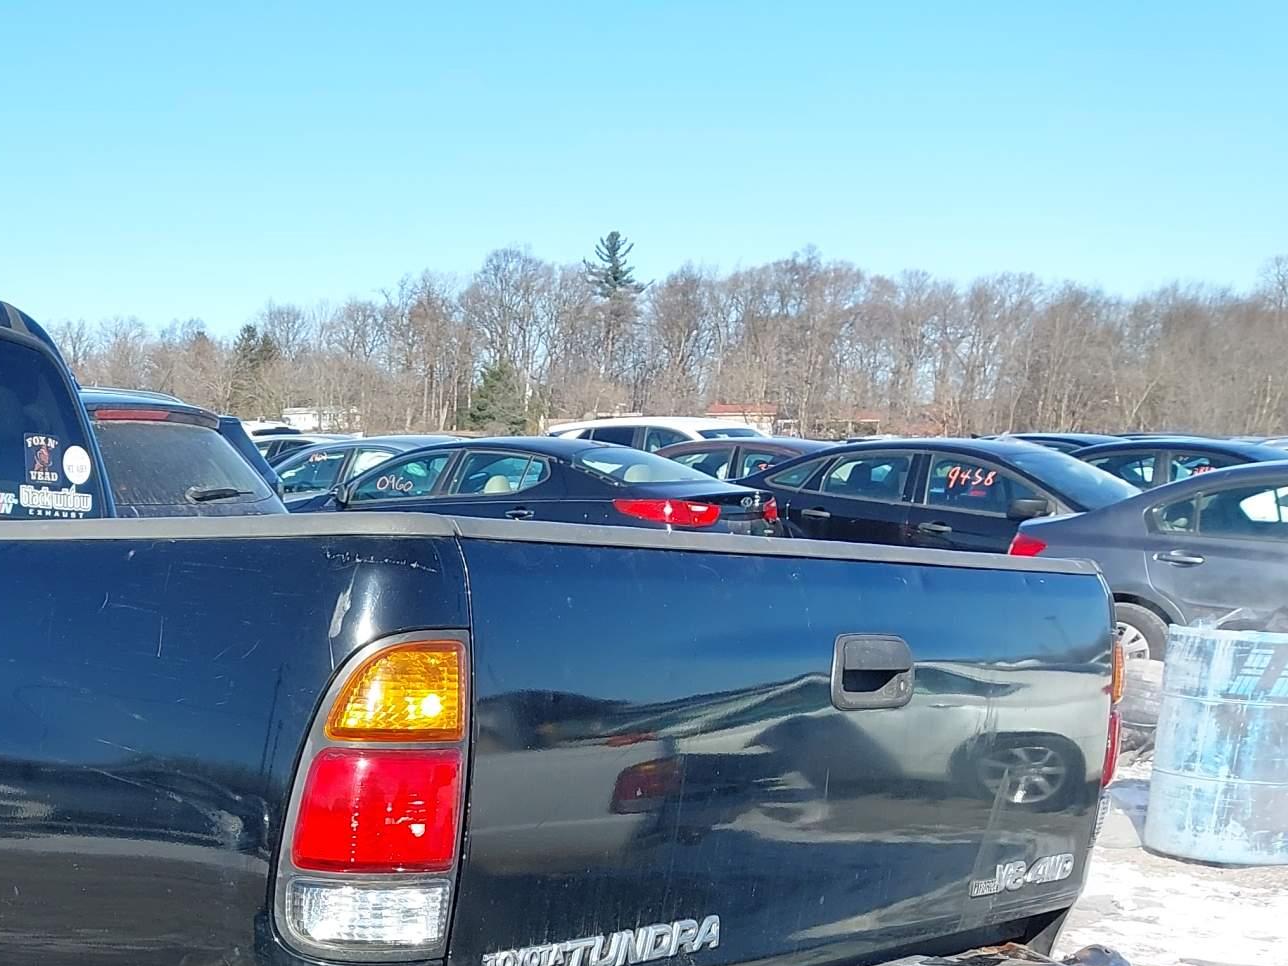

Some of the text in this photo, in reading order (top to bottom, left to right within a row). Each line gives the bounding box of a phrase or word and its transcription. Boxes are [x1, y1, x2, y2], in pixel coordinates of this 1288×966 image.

[26, 436, 46, 448] FOX
[376, 475, 413, 492] 0960
[20, 485, 92, 511] black widow
[28, 509, 85, 519] EXHAUST
